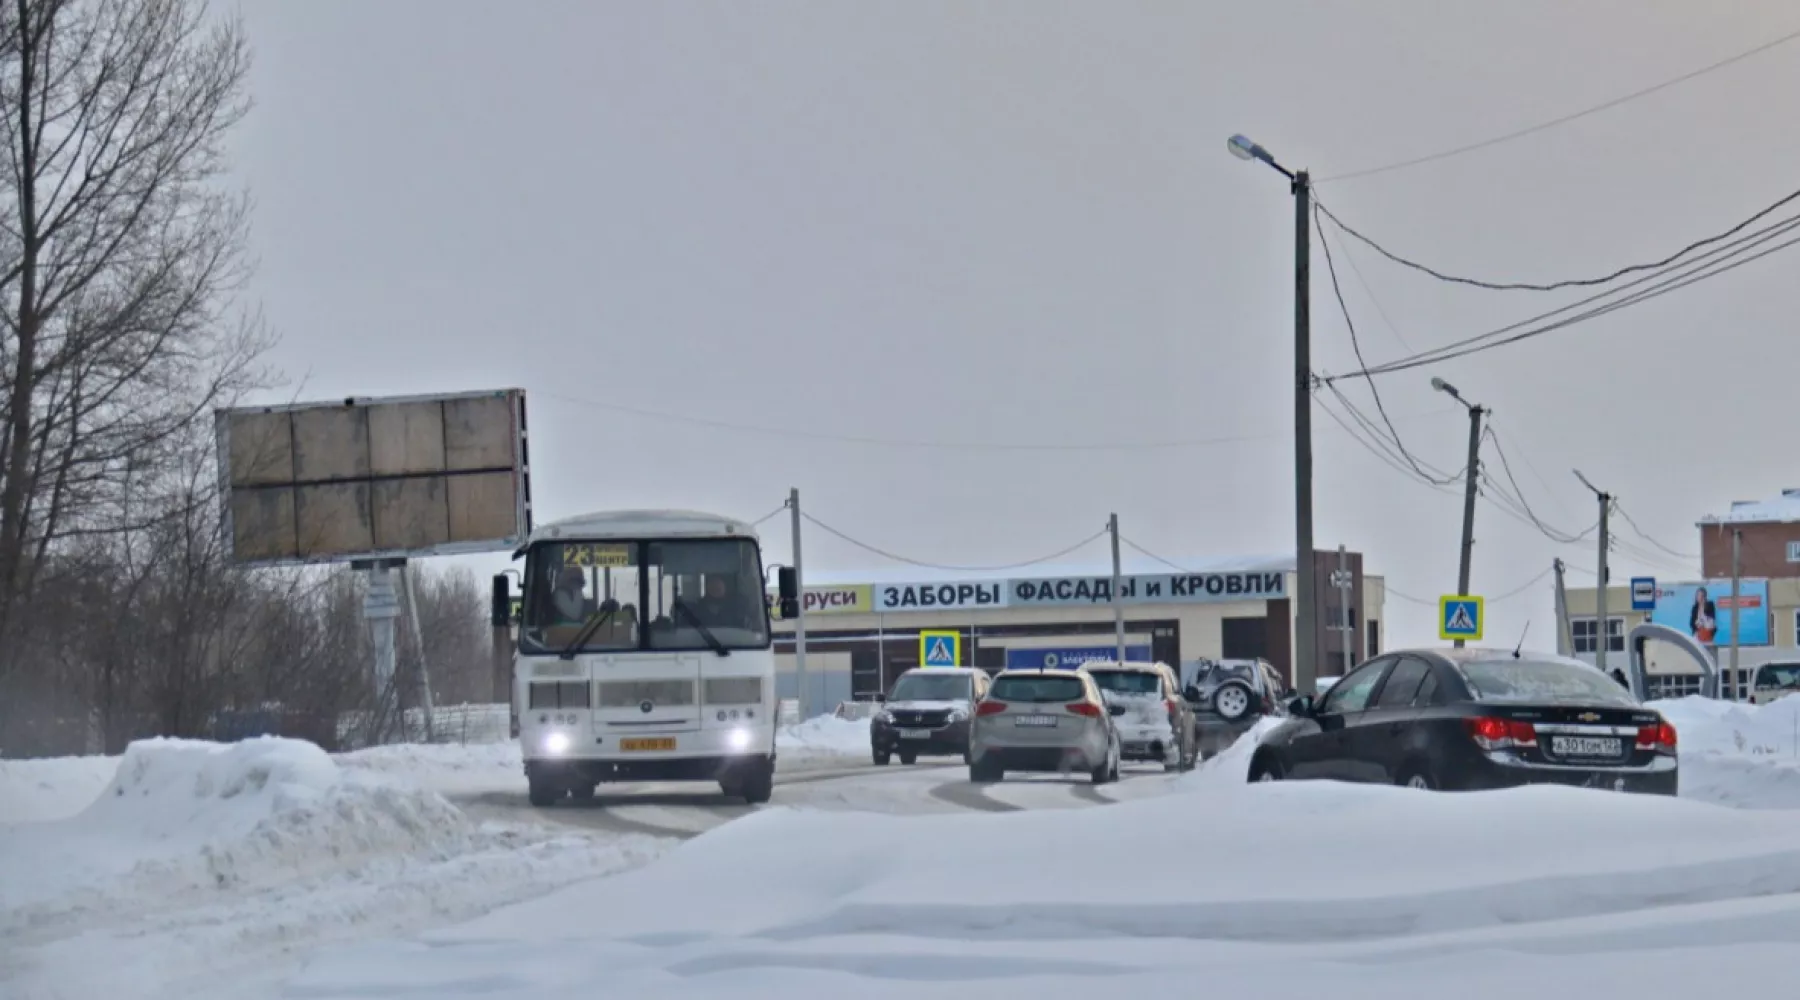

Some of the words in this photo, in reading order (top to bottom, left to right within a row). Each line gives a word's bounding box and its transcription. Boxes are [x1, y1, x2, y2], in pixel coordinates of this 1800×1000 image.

[565, 544, 594, 565] 23
[883, 584, 1000, 607] ЗАБОРЫ
[1015, 577, 1136, 603] ФАСАДЫ
[1145, 581, 1161, 597] и
[1171, 573, 1282, 597] КРОВЛИ
